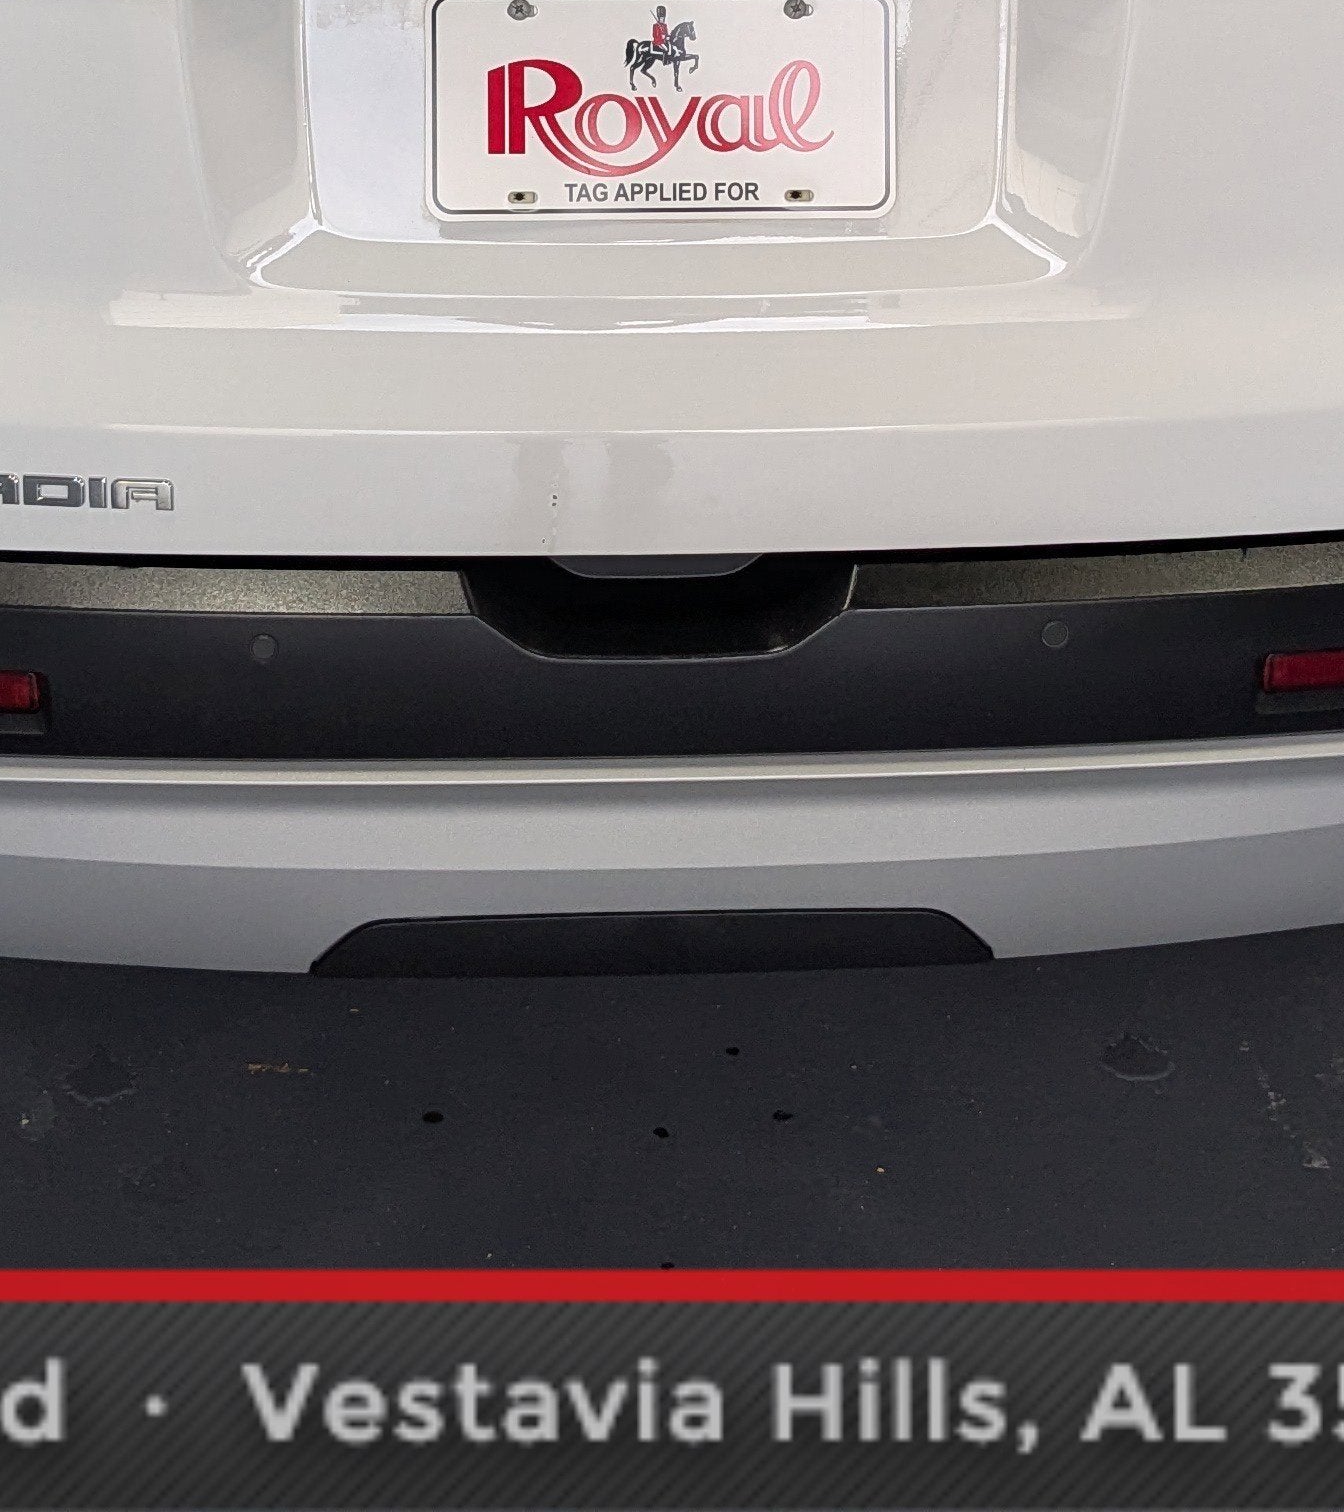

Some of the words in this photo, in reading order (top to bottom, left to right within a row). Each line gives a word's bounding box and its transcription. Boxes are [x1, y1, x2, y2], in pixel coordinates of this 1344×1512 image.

[486, 58, 834, 177] Royal
[564, 182, 609, 203] TAG
[613, 182, 708, 202] APPLIED
[714, 181, 760, 201] FOR
